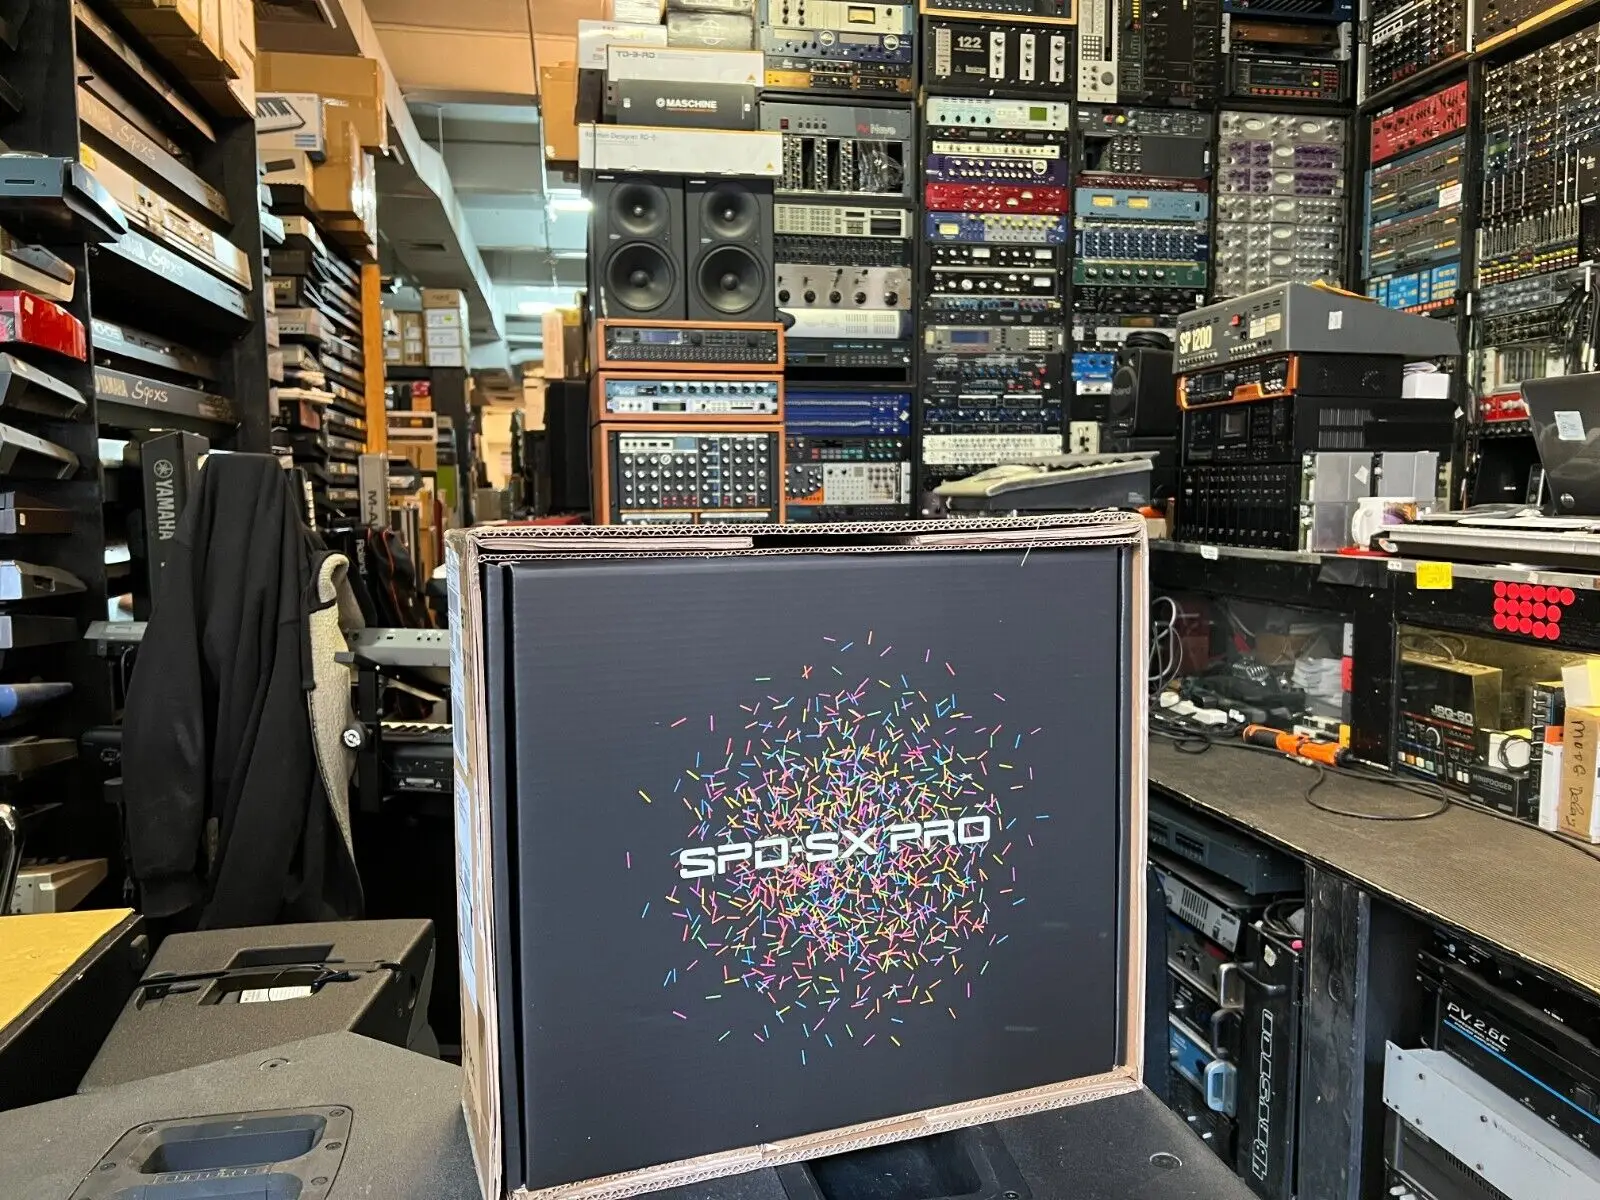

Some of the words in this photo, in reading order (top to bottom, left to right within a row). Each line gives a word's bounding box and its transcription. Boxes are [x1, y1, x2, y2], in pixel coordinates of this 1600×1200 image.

[957, 36, 982, 49] 122
[666, 98, 718, 109] MASCHINE
[1180, 331, 1192, 354] SP
[1192, 325, 1213, 351] 1200
[155, 479, 176, 540] YAMAHA
[679, 827, 878, 879] SPD-SX
[889, 815, 991, 852] PRO
